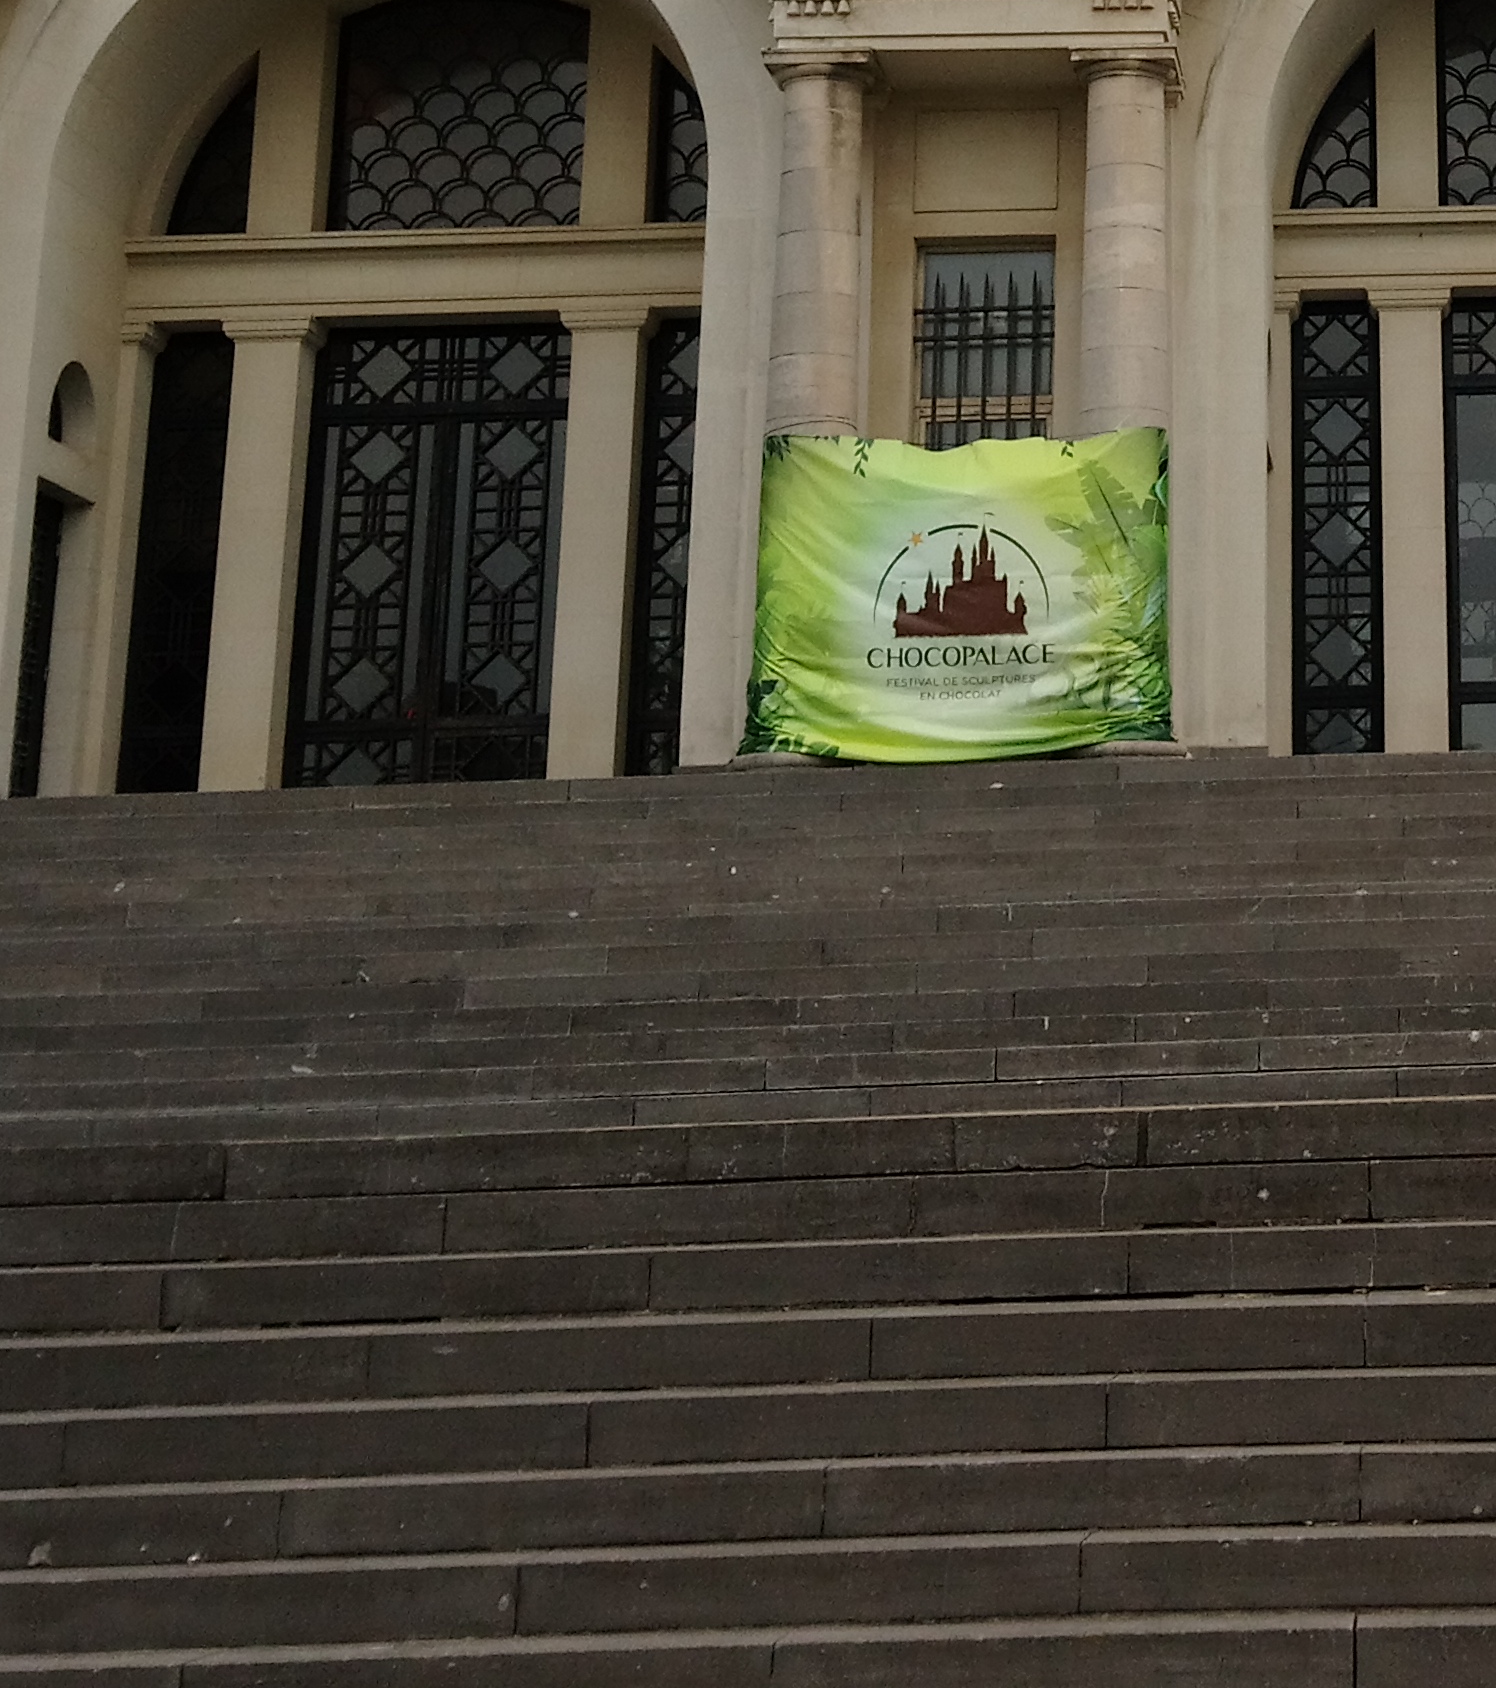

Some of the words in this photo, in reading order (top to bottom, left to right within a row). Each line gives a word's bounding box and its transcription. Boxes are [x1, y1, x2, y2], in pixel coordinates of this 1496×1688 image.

[866, 643, 1056, 669] CHOCOPALACE
[886, 677, 939, 688] FESTIVAL
[943, 676, 958, 686] DE
[962, 674, 1036, 686] SCULPTURES
[920, 691, 935, 700] EN
[939, 689, 1002, 700] CHOCOLAT
